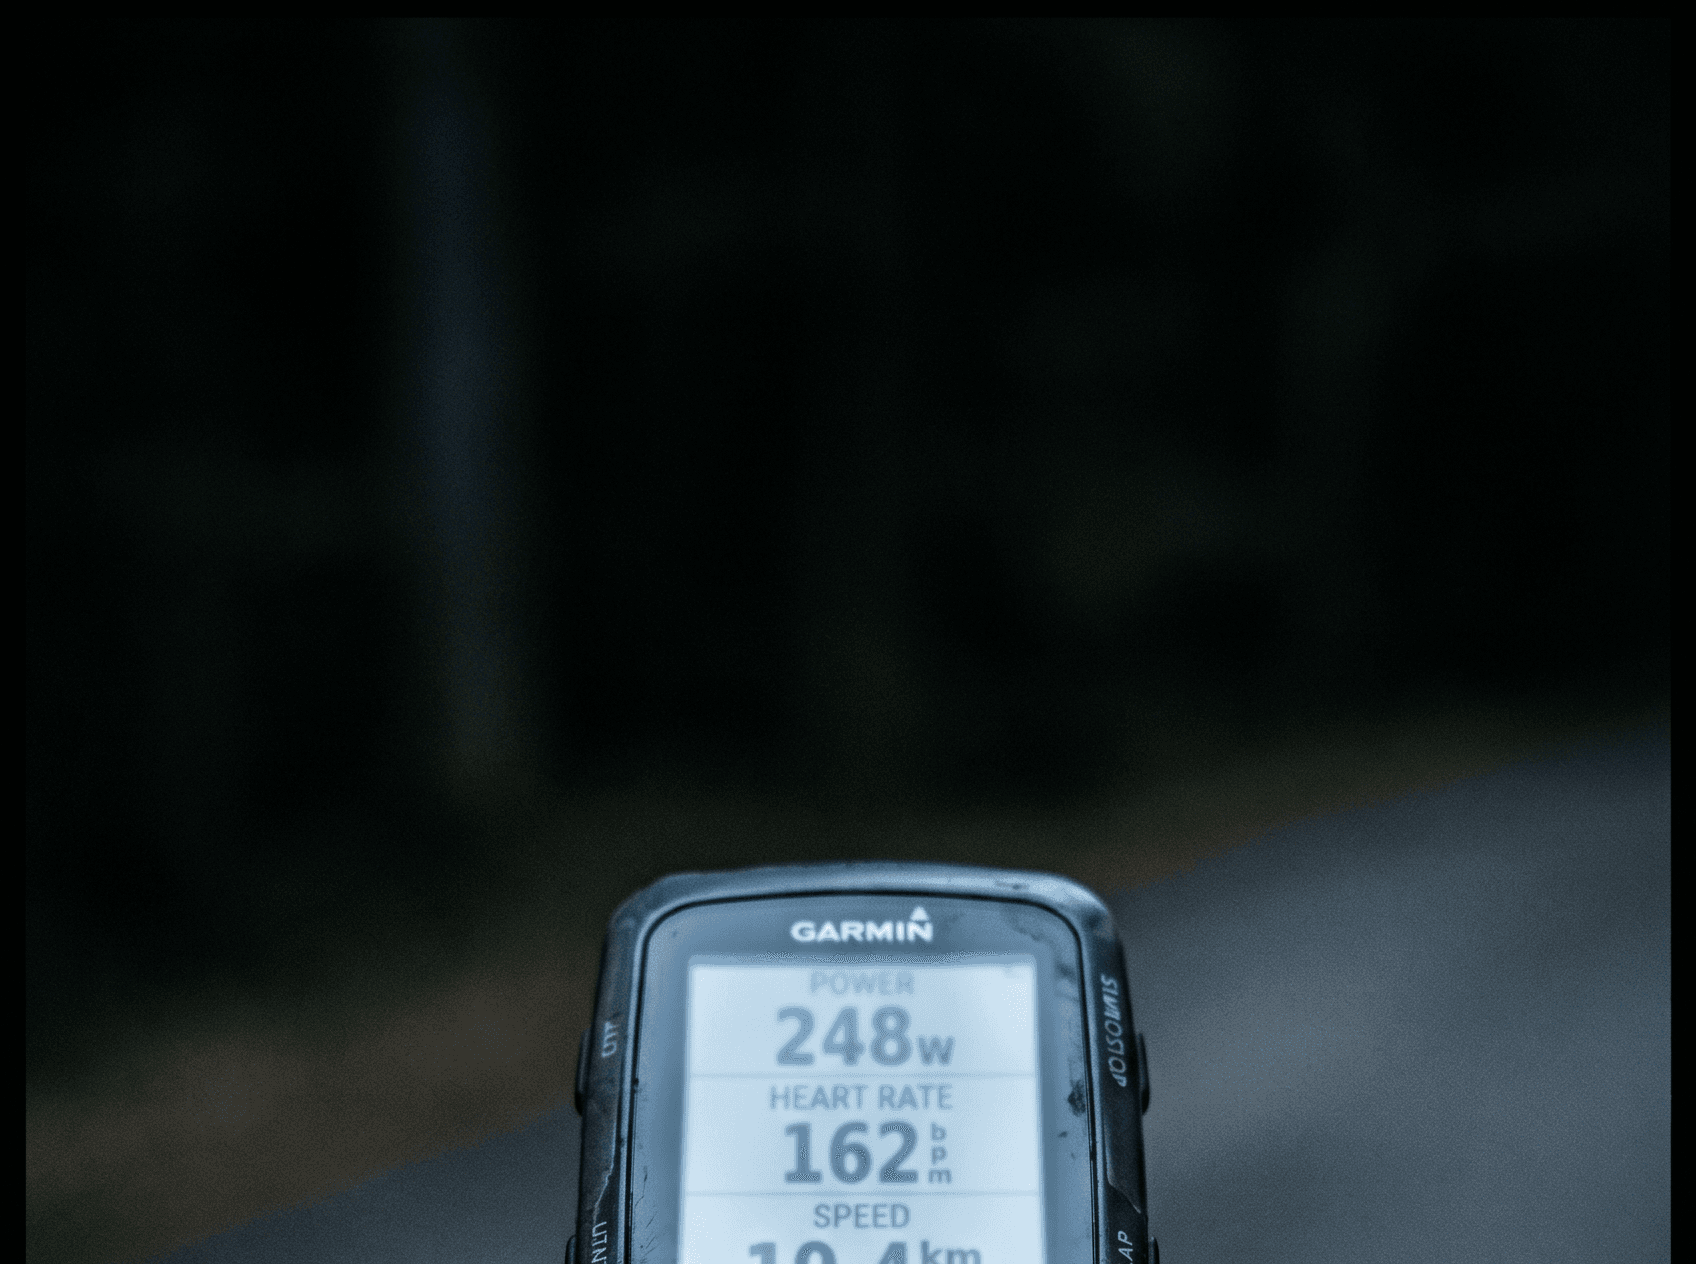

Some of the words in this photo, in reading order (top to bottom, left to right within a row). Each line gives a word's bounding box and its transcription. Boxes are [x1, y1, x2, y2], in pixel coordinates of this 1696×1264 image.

[790, 920, 933, 942] GARMIN
[768, 1083, 868, 1110] HEART
[876, 1083, 954, 1110] RATE
[784, 1121, 918, 1184] 162
[813, 1203, 911, 1229] SPEED
